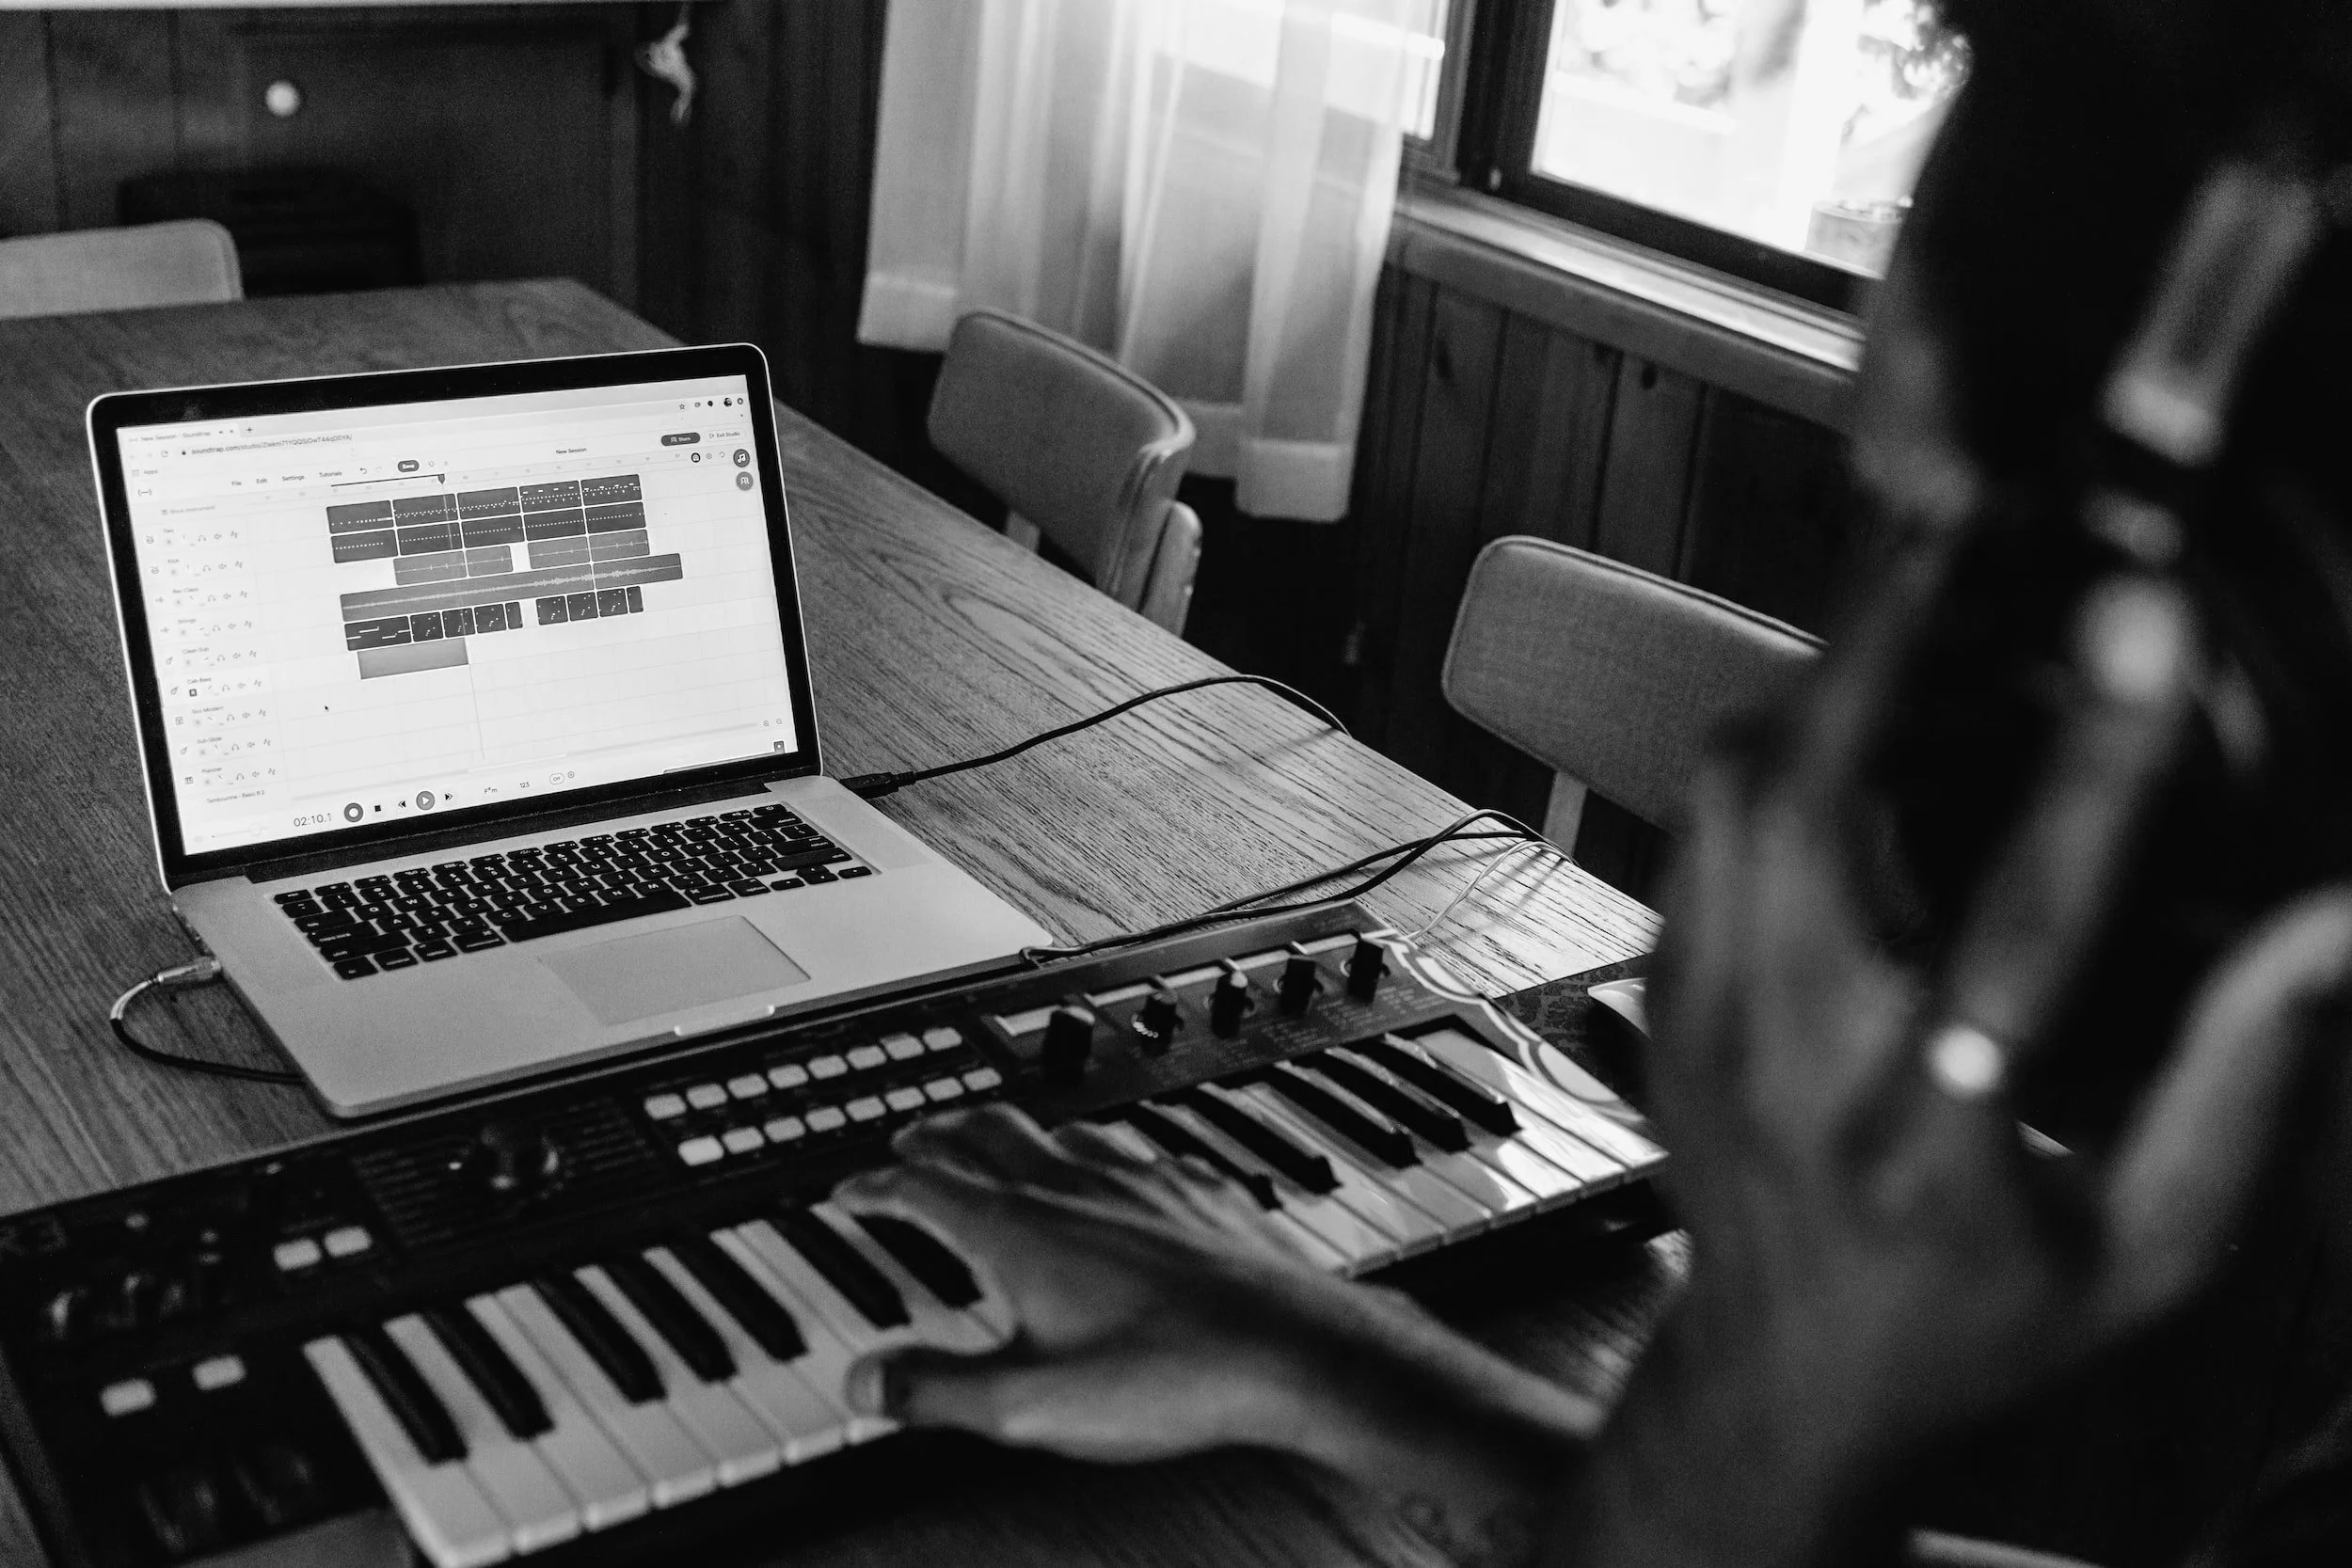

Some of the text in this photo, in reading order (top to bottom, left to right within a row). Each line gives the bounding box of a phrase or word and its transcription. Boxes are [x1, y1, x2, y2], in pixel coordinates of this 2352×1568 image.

[281, 474, 306, 483] Settings
[318, 470, 343, 479] Tutorials
[293, 812, 332, 828] 02:10.1
